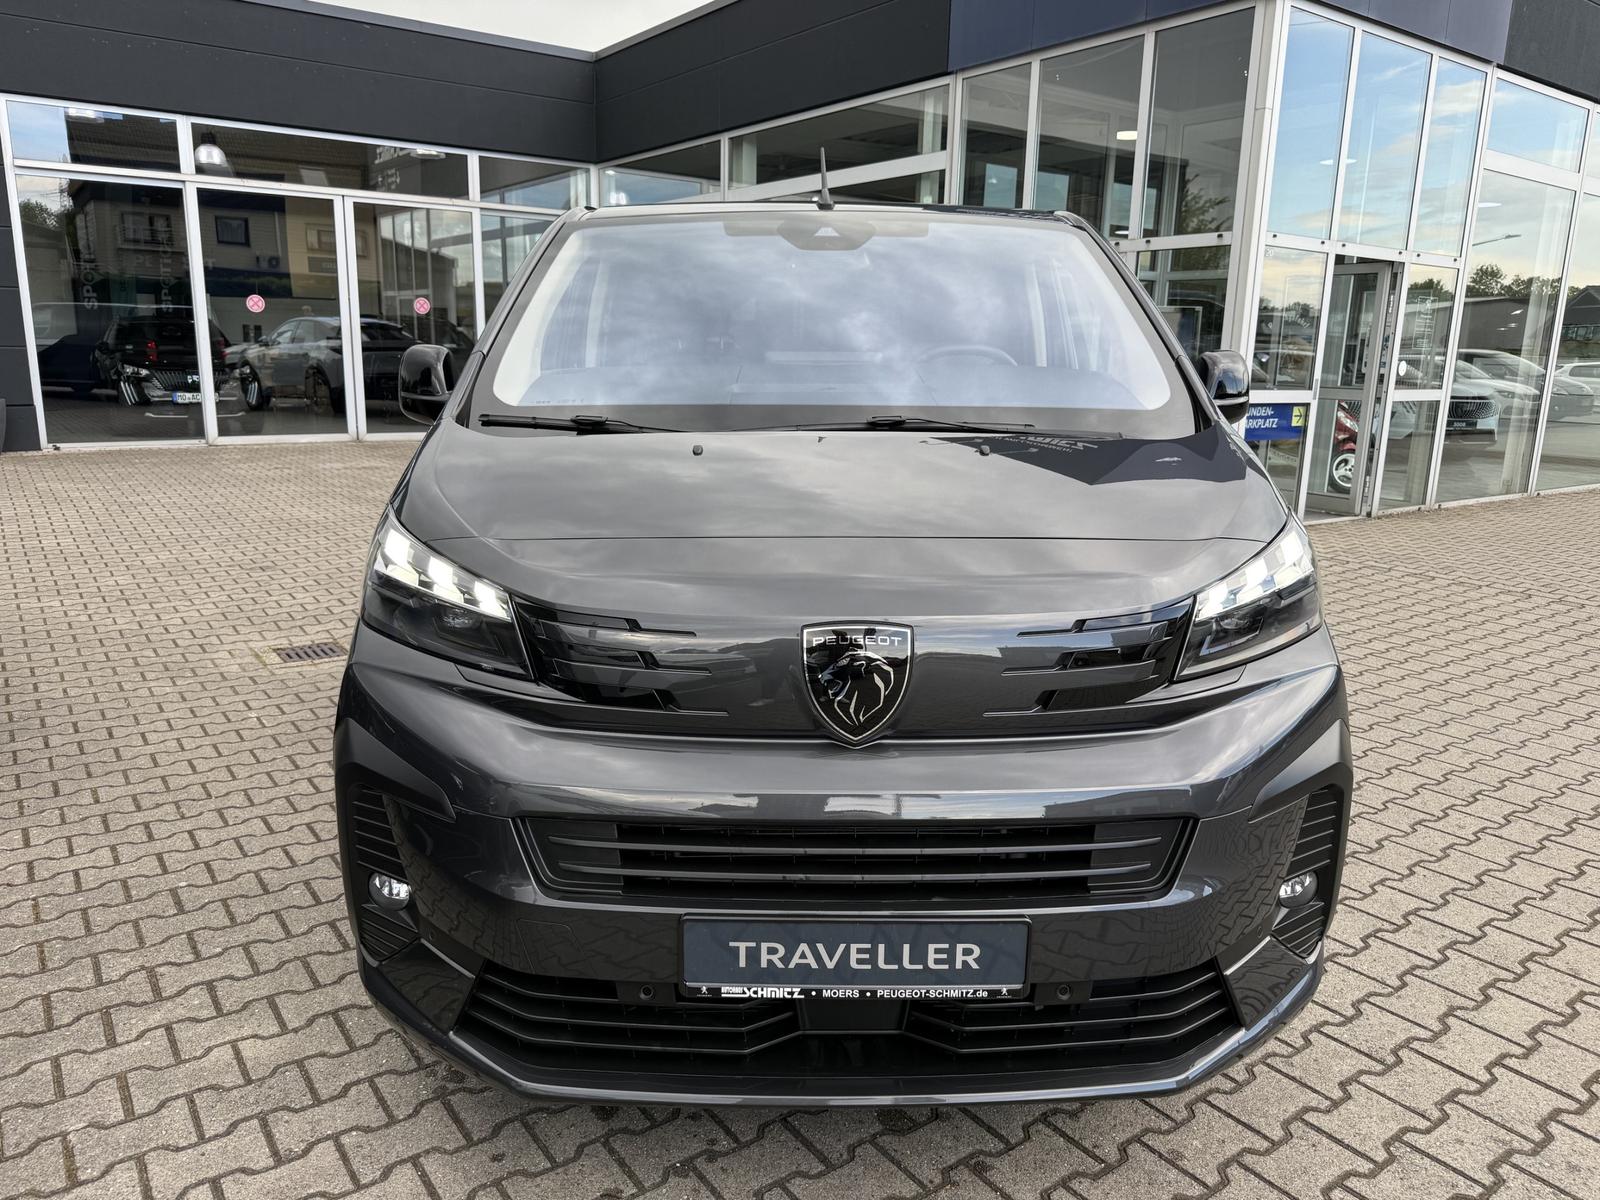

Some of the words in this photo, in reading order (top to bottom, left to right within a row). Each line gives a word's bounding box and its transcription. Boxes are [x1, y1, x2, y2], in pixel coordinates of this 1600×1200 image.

[1247, 406, 1275, 417] UNDEN-
[1246, 418, 1279, 429] ARKPLATZ
[812, 635, 902, 647] PEUGEOT
[728, 941, 981, 970] TRAVELLER
[735, 986, 805, 998] SCHMITZ
[822, 989, 860, 998] MOERS
[877, 989, 988, 998] PEUGEOT-SCHMITZ.de
